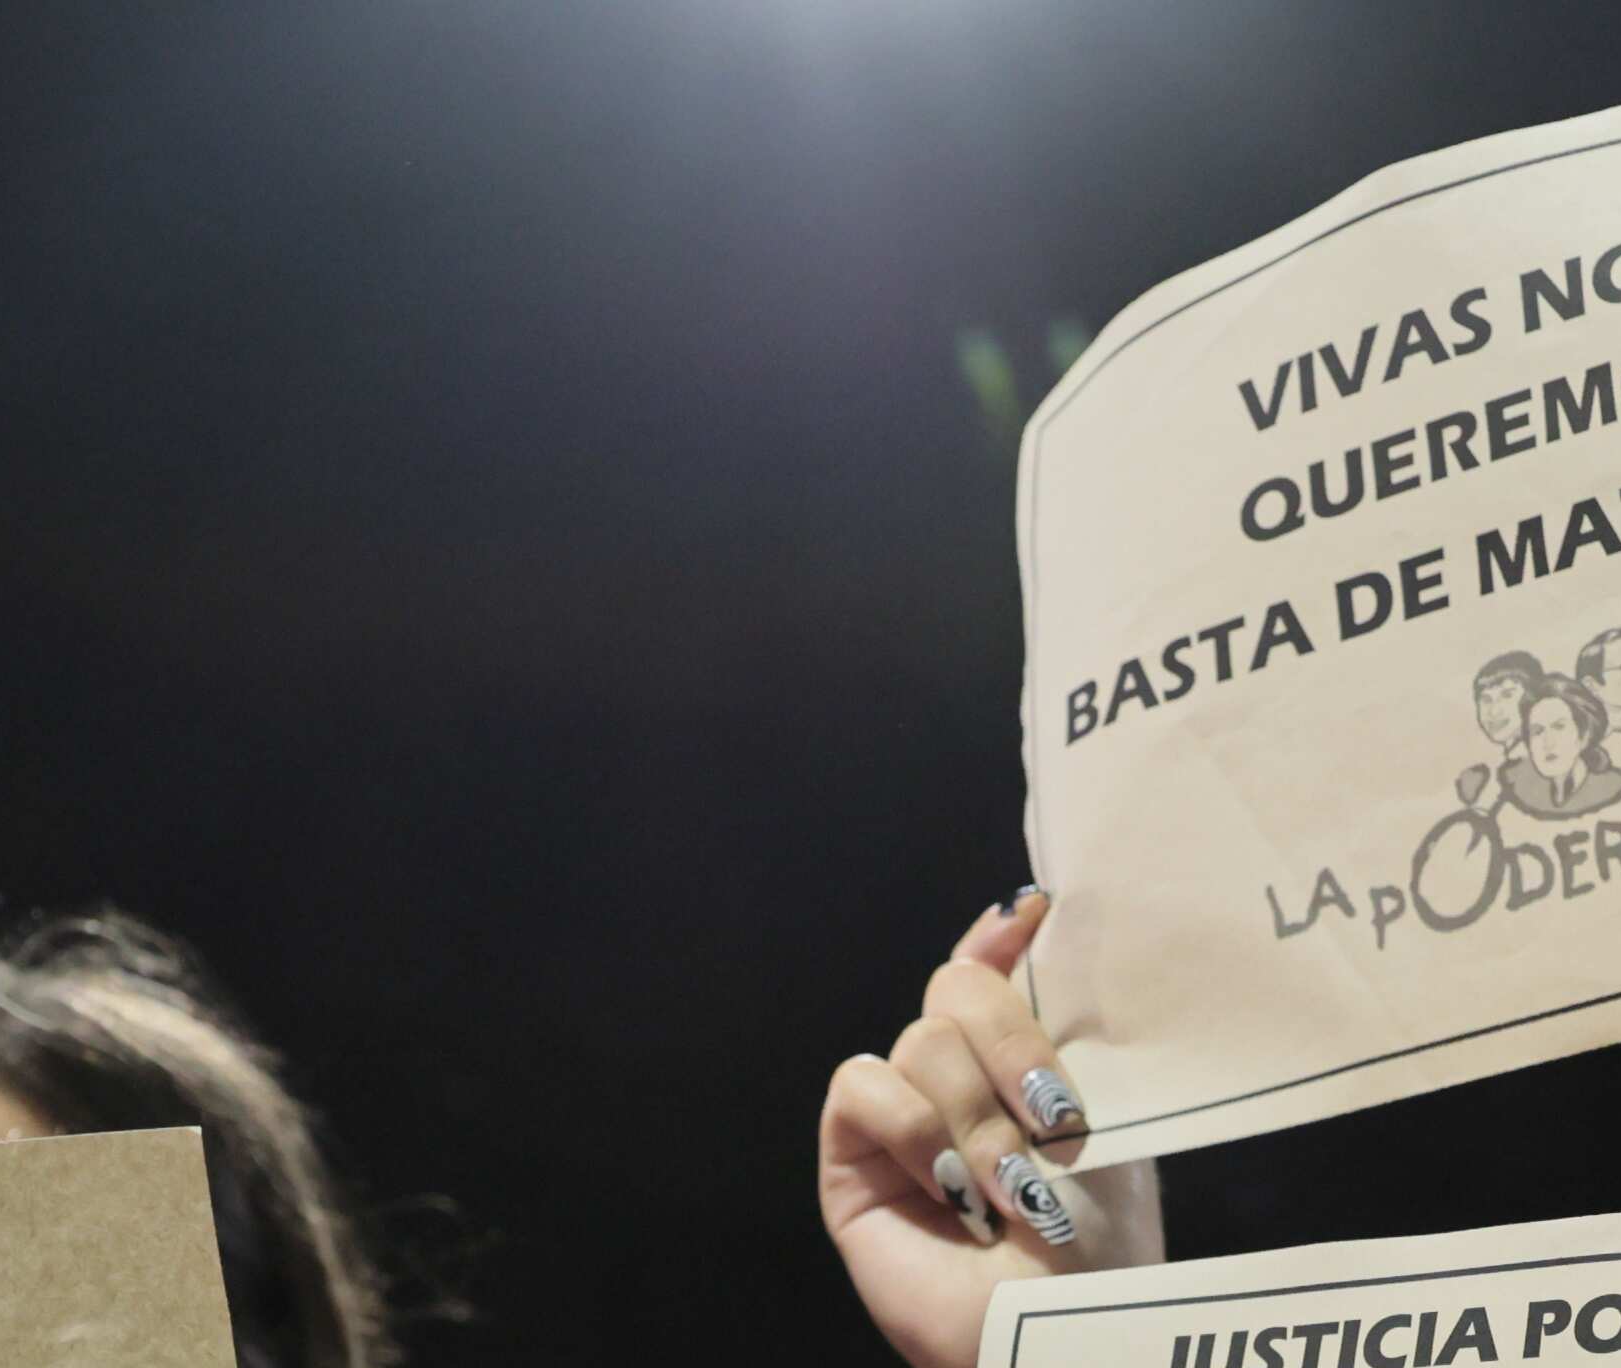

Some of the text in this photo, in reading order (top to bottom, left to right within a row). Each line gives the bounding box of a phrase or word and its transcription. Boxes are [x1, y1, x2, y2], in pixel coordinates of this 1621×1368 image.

[1239, 288, 1491, 431] VIVAS
[1067, 601, 1314, 745] BASTA
[1335, 548, 1449, 641] DE
[1266, 866, 1356, 940] LA
